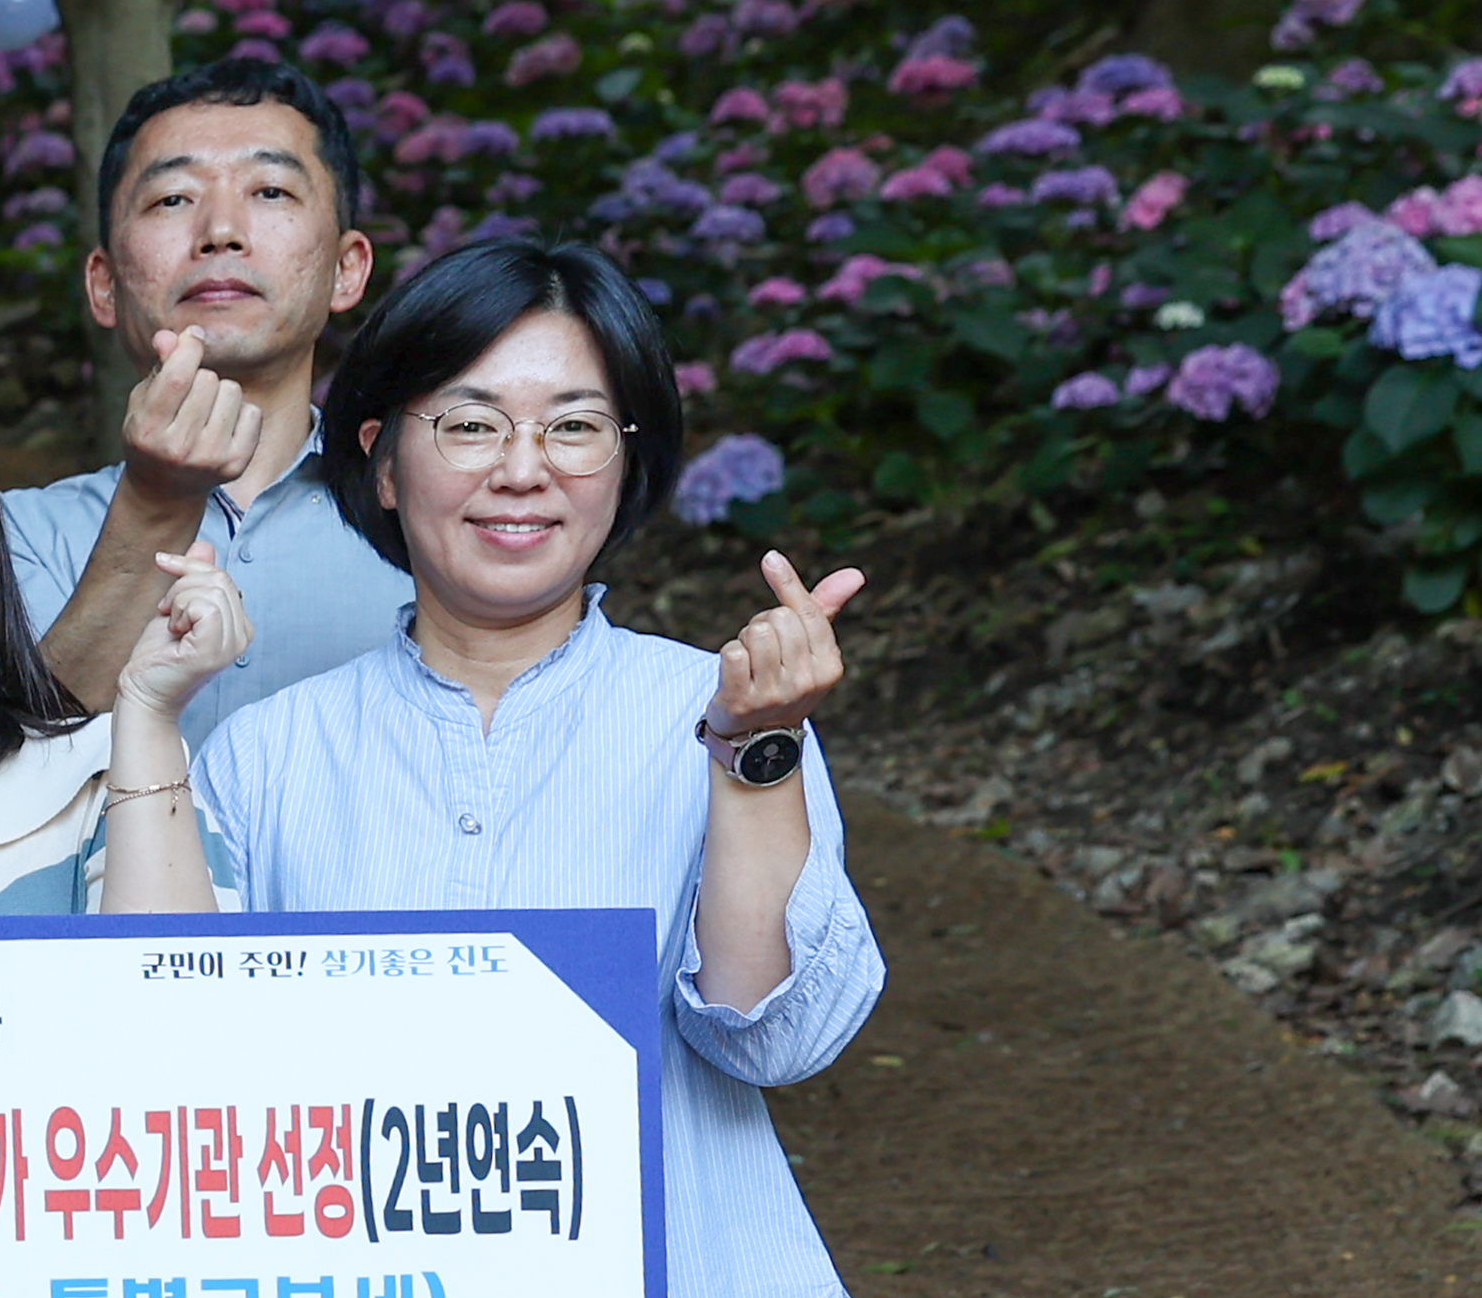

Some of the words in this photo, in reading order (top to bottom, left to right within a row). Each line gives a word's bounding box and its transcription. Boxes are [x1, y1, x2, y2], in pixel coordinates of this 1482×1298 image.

[142, 952, 223, 979] 군민이
[240, 951, 306, 978] 주인!
[323, 949, 431, 976] 살기좋은
[448, 945, 509, 975] 진도
[45, 1106, 242, 1240] 우수기관
[257, 1096, 583, 1243] 선정(2년연속)
